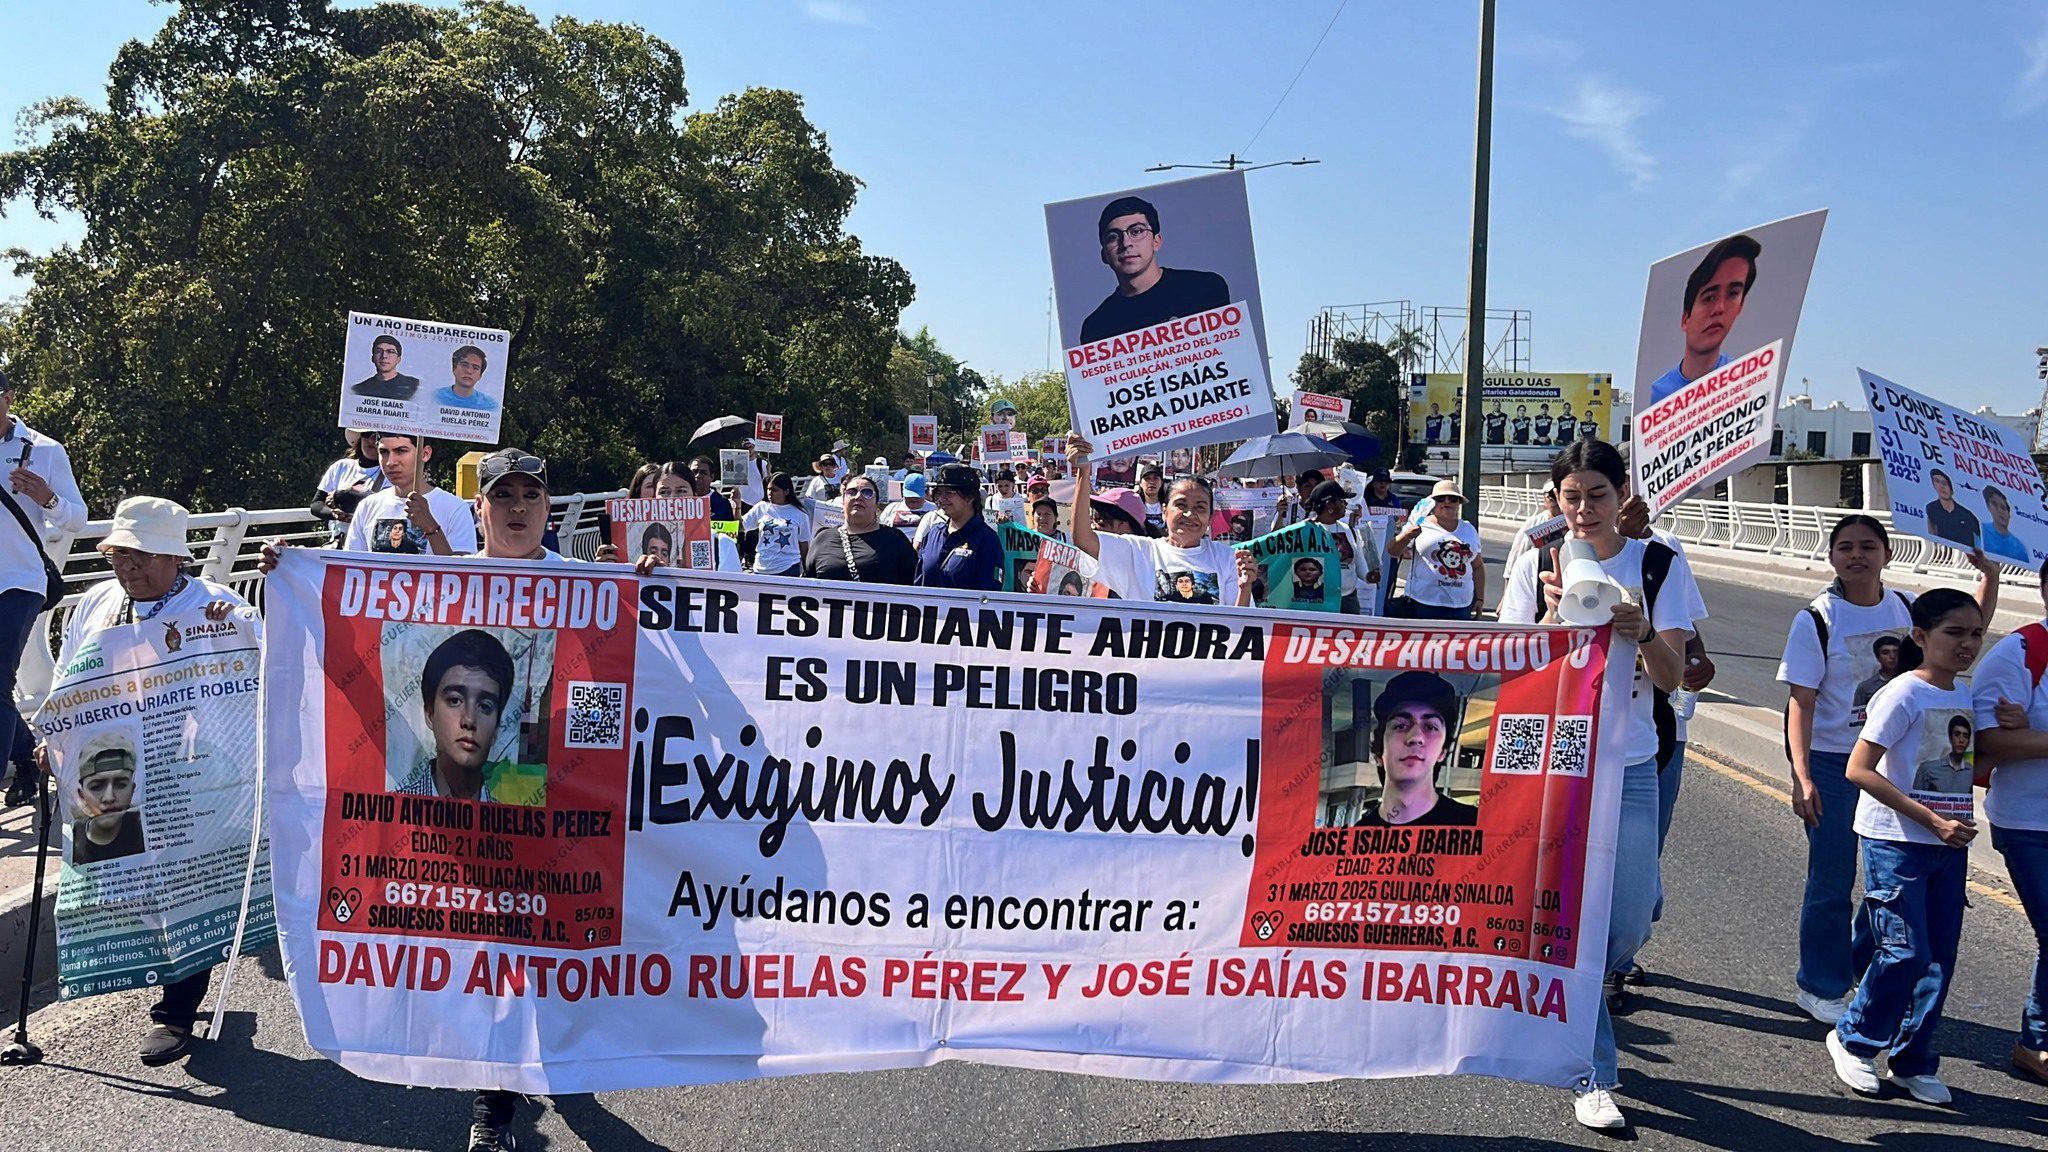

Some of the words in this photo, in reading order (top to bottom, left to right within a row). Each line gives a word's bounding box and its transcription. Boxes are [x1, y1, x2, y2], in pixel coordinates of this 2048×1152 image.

[354, 316, 372, 326] UN
[375, 318, 402, 330] AÑO
[406, 323, 504, 343] DESAPARECIDOS
[1068, 306, 1242, 369] DESAPARECIDO
[1081, 364, 1113, 379] DESDE
[1114, 360, 1126, 371] EL
[1127, 357, 1138, 367] 31
[1139, 353, 1152, 363] DE
[1153, 342, 1191, 360] MARZO
[1193, 337, 1212, 349] DEL
[1214, 328, 1240, 343] 2025
[1104, 376, 1118, 386] EN
[1119, 361, 1173, 382] CULIACÁN,
[1174, 348, 1224, 367] SINALOA.
[1107, 376, 1157, 409] JOSÉ
[1161, 361, 1229, 394] ISAÍAS
[1482, 378, 1524, 387] GULLO
[1527, 378, 1552, 387] UAS
[1508, 389, 1558, 397] Galardonados
[1640, 349, 1774, 434] DESAPARECIDO
[356, 406, 382, 416] IBARRA
[383, 409, 410, 419] DUARTE
[362, 398, 380, 407] JOSÉ
[381, 399, 404, 410] ISAÍAS
[440, 407, 460, 416] DAVID
[461, 410, 491, 419] ANTONIO
[1090, 402, 1168, 436] IBARRA
[1170, 378, 1251, 414] DUARTE
[1644, 428, 1668, 447] DESDE
[1668, 422, 1678, 433] EL
[1678, 417, 1688, 427] 31
[1688, 411, 1698, 422] DE
[1698, 393, 1729, 416] MARZO
[1729, 384, 1744, 399] DEL
[1745, 371, 1768, 390] 2025
[441, 416, 467, 426] RUELAS
[468, 418, 490, 428] PÉREZ
[1112, 426, 1170, 451] EXIGIMOS
[1171, 423, 1188, 435] TU
[1189, 407, 1243, 429] REGRESO
[1658, 439, 1669, 450] EN
[1670, 413, 1711, 444] CULIACÁN,
[1711, 392, 1750, 423] SINALOA.
[1952, 413, 2004, 447] ESTÁN
[1641, 438, 1691, 482] DAVID
[1691, 394, 1767, 445] ANTONIO
[1878, 425, 1904, 451] 31
[1895, 412, 1929, 439] LOS
[1936, 426, 2038, 478] ESTUDIANTES
[1647, 450, 1702, 499] RUELAS
[1706, 418, 1756, 459] PÉREZ
[1882, 446, 1922, 472] MARZO
[1920, 441, 1945, 466] DE
[1659, 474, 1698, 507] EXIGIMOS
[1698, 463, 1710, 479] TU
[1710, 440, 1751, 470] REGRESO
[1888, 463, 1921, 484] 2025
[612, 497, 704, 522] DESAPARECIDO
[1894, 501, 1925, 519] ISAÍAS
[711, 522, 724, 530] SU
[1005, 527, 1041, 552] MADR
[1042, 540, 1081, 569] DESAPA
[1265, 528, 1305, 556] CASA
[1307, 527, 1335, 554] A.C.
[339, 567, 620, 631] DESAPARECIDO
[186, 622, 236, 637] SINALOA
[219, 630, 238, 638] ESTADO
[638, 584, 739, 634] SER
[757, 594, 1076, 656] ESTUDIANTE
[1089, 616, 1265, 661] AHORA
[1283, 626, 1551, 672] DESAPARECIDO
[44, 683, 121, 715] Ayúdanos
[127, 680, 138, 693] a
[143, 660, 227, 689] encontrar
[233, 659, 245, 672] a
[765, 656, 828, 704] ES
[845, 660, 917, 707] UN
[932, 663, 1138, 715] PELIGRO
[74, 702, 132, 728] ALBERTO
[136, 686, 196, 713] URIARTE
[200, 677, 260, 699] ROBLES
[176, 771, 201, 780] Delgada
[629, 706, 957, 858] ¡Exigimos
[972, 730, 1260, 859] Justicia!
[161, 806, 188, 815] Mediana
[194, 809, 216, 818] Oscuro
[341, 792, 395, 824] DAVID
[400, 795, 474, 831] ANTONIO
[479, 804, 547, 839] RUELAS
[552, 810, 612, 838] PEREZ
[164, 832, 186, 840] Grande
[167, 822, 194, 831] Mediana
[1301, 825, 1348, 857] JOSÉ
[1353, 825, 1412, 855] ISAÍAS
[1416, 828, 1484, 856] IBARRA
[216, 848, 229, 857] tipo
[411, 831, 452, 856] EDAD:
[455, 835, 472, 857] 21
[477, 834, 514, 862] AÑOS
[340, 854, 361, 878] 31
[366, 856, 418, 882] MARZO
[421, 860, 460, 883] 2025
[463, 862, 535, 892] CULIACÁN
[537, 870, 603, 896] SINALOA
[1335, 856, 1375, 878] EDAD:
[1377, 857, 1395, 876] 23
[1398, 853, 1436, 877] AÑOS
[384, 881, 548, 917] 6671571930
[667, 869, 892, 933] Ayúdanos
[905, 899, 930, 930] a
[944, 888, 1153, 933] encontrar
[1163, 897, 1201, 933] a:
[1267, 883, 1286, 903] 31
[1288, 882, 1339, 903] MARZO
[1341, 880, 1378, 901] 2025
[1381, 878, 1451, 904] CULIACÁN
[1454, 882, 1515, 907] SINALOA
[368, 904, 445, 933] SABUESOS
[449, 909, 537, 943] GUERRERAS,
[541, 919, 571, 944] A.C.
[575, 905, 615, 923] 85/03
[1304, 901, 1461, 926] 6671571930
[61, 949, 69, 960] Si
[71, 946, 95, 958] tienes
[97, 934, 155, 952] información
[203, 919, 210, 928] a
[214, 909, 238, 923] esta
[1287, 922, 1361, 943] SABUESOS
[1363, 925, 1449, 949] GUERRERAS,
[1453, 928, 1480, 949] A.C.
[1486, 917, 1526, 933] 86/03
[1533, 922, 1572, 941] 86/03
[61, 960, 81, 972] llama
[82, 960, 88, 969] o
[149, 946, 160, 957] Tu
[189, 934, 202, 945] es
[203, 923, 227, 940] muy
[83, 983, 95, 993] 667
[97, 976, 133, 990] 1841256
[318, 939, 452, 993] DAVID
[463, 950, 672, 1002] ANTONIO
[688, 954, 868, 1000] RUELAS
[883, 951, 1026, 1002] PÉREZ
[1041, 963, 1070, 1001] Y
[1081, 951, 1192, 1000] JOSÉ
[1206, 949, 1348, 1001] ISAÍAS
